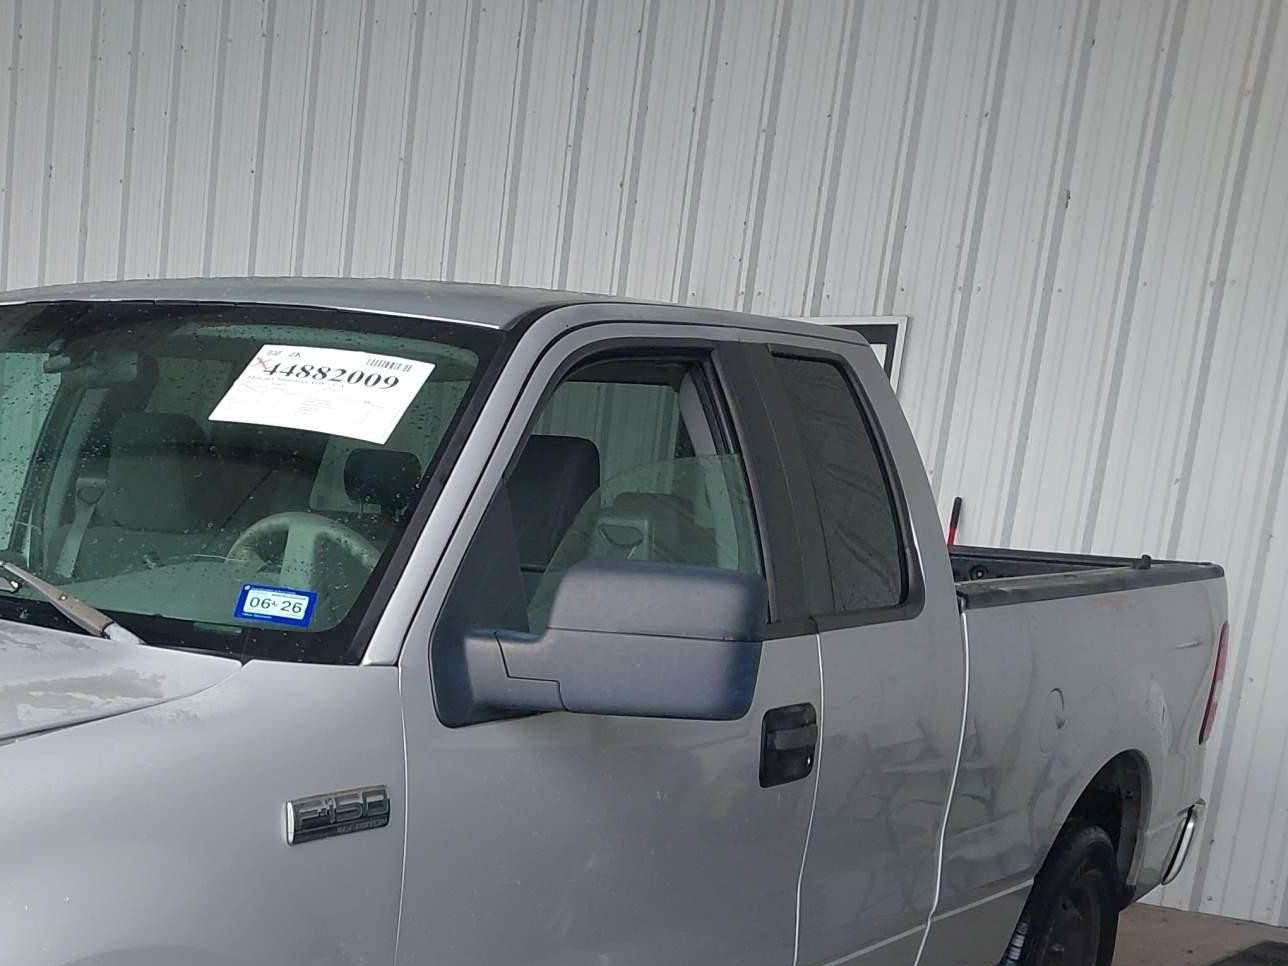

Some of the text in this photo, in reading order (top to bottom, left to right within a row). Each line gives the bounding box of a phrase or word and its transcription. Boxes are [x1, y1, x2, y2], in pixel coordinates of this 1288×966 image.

[263, 362, 400, 390] 44882009
[249, 596, 272, 610] 06
[280, 600, 304, 614] 26
